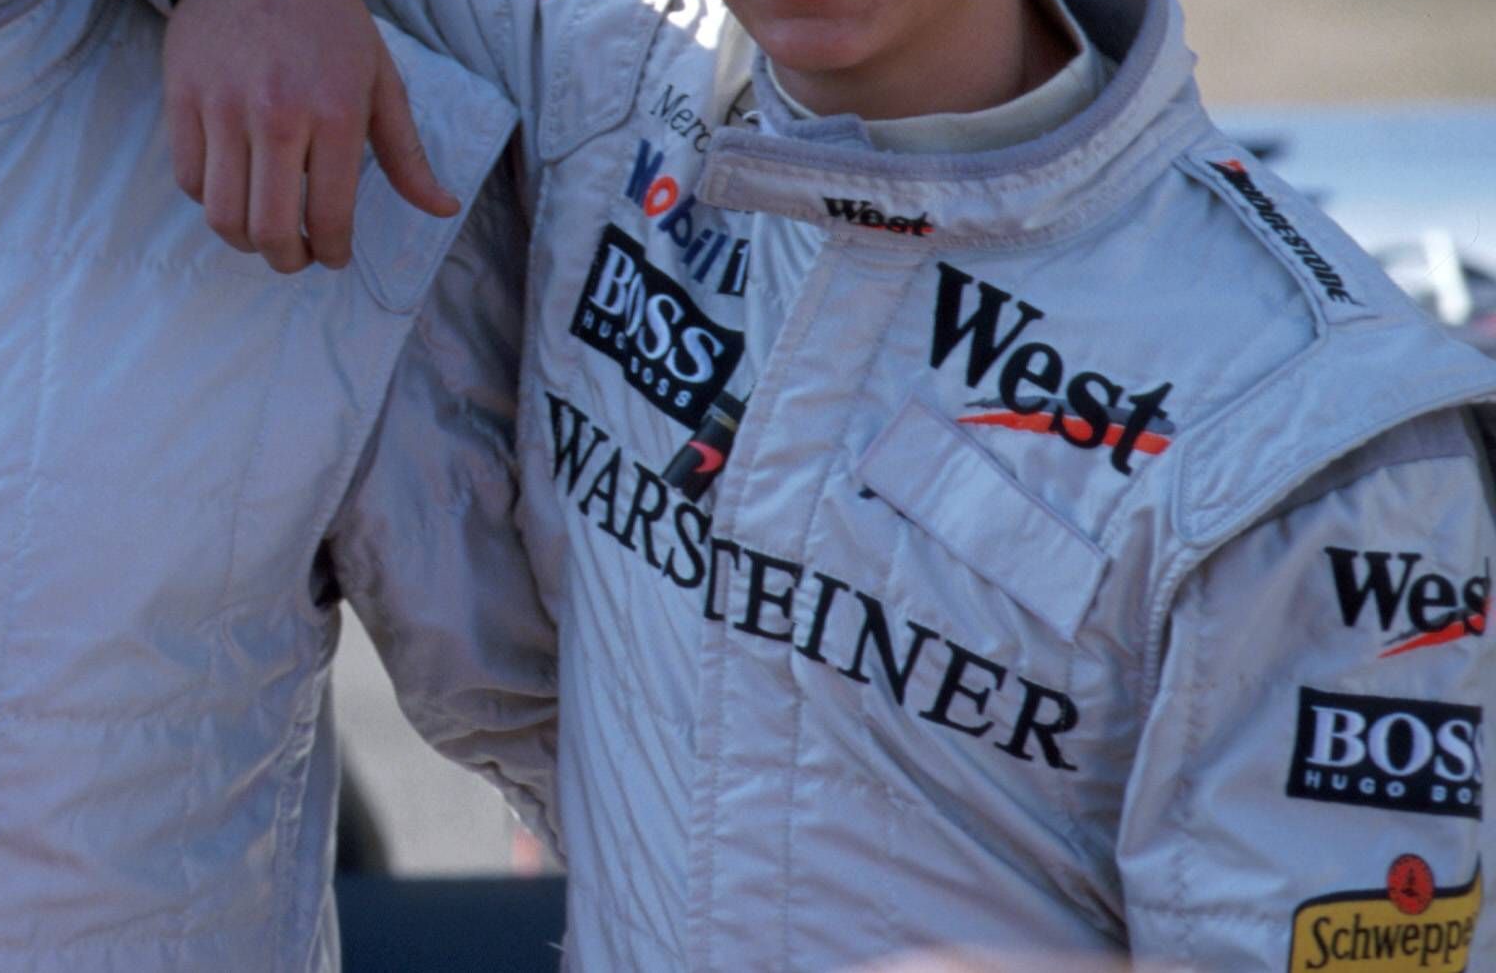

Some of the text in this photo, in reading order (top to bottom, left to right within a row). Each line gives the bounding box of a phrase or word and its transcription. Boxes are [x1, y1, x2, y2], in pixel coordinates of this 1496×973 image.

[624, 138, 729, 286] Mobil
[822, 196, 931, 237] West
[588, 242, 725, 384] BOSS
[929, 262, 1175, 476] West
[544, 392, 1080, 773] WARSTEINER
[1323, 546, 1490, 636] Wes
[1304, 769, 1481, 807] HUGO BO
